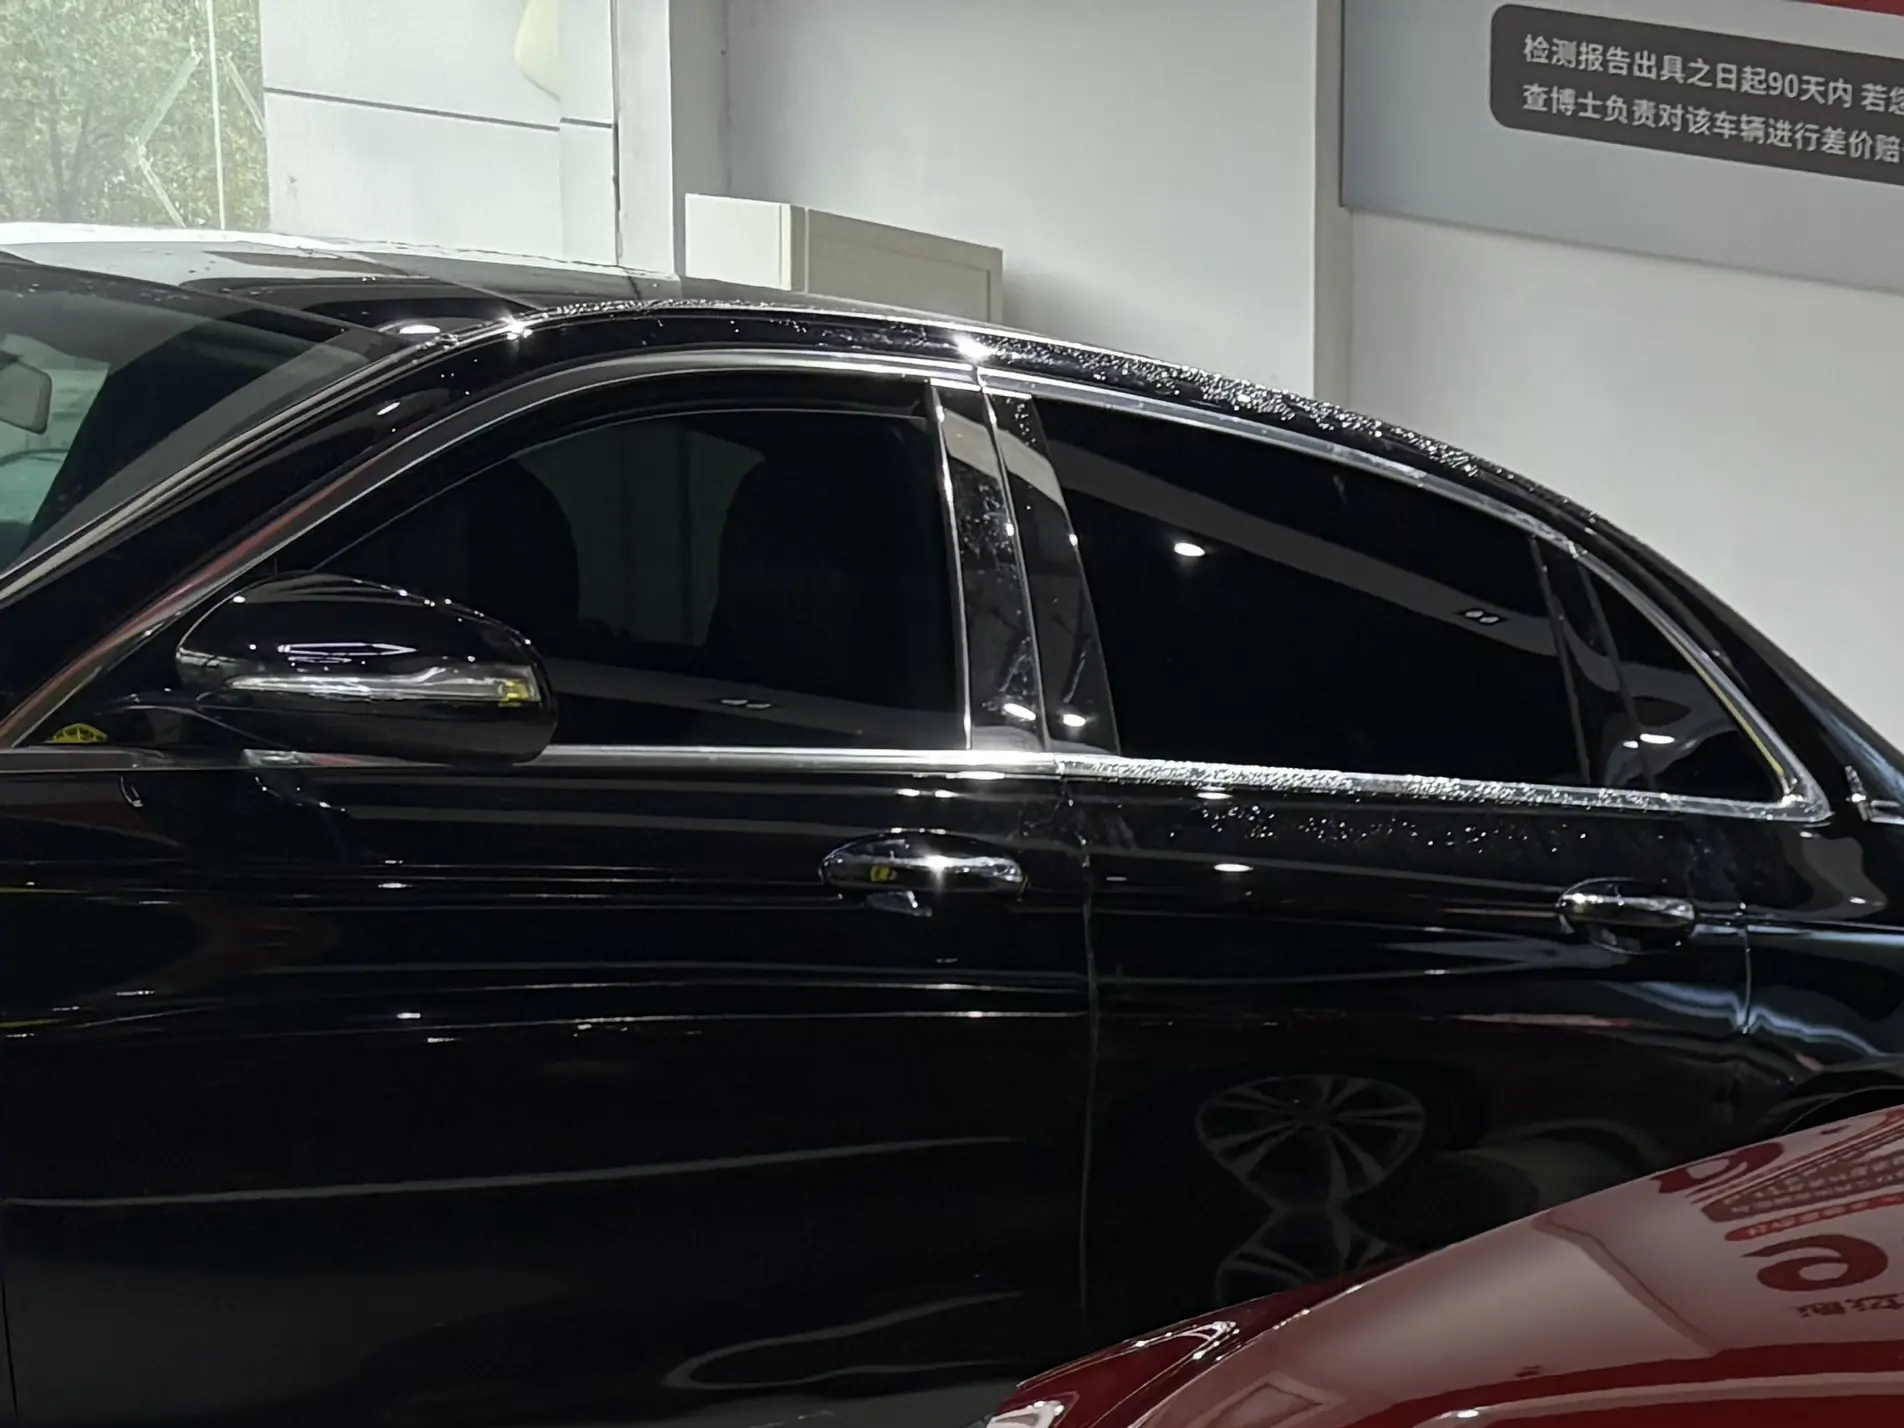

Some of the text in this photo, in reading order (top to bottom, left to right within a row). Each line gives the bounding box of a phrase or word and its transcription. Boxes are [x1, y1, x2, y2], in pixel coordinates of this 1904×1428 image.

[1523, 33, 1853, 108] 检测报告出具之日起90天内
